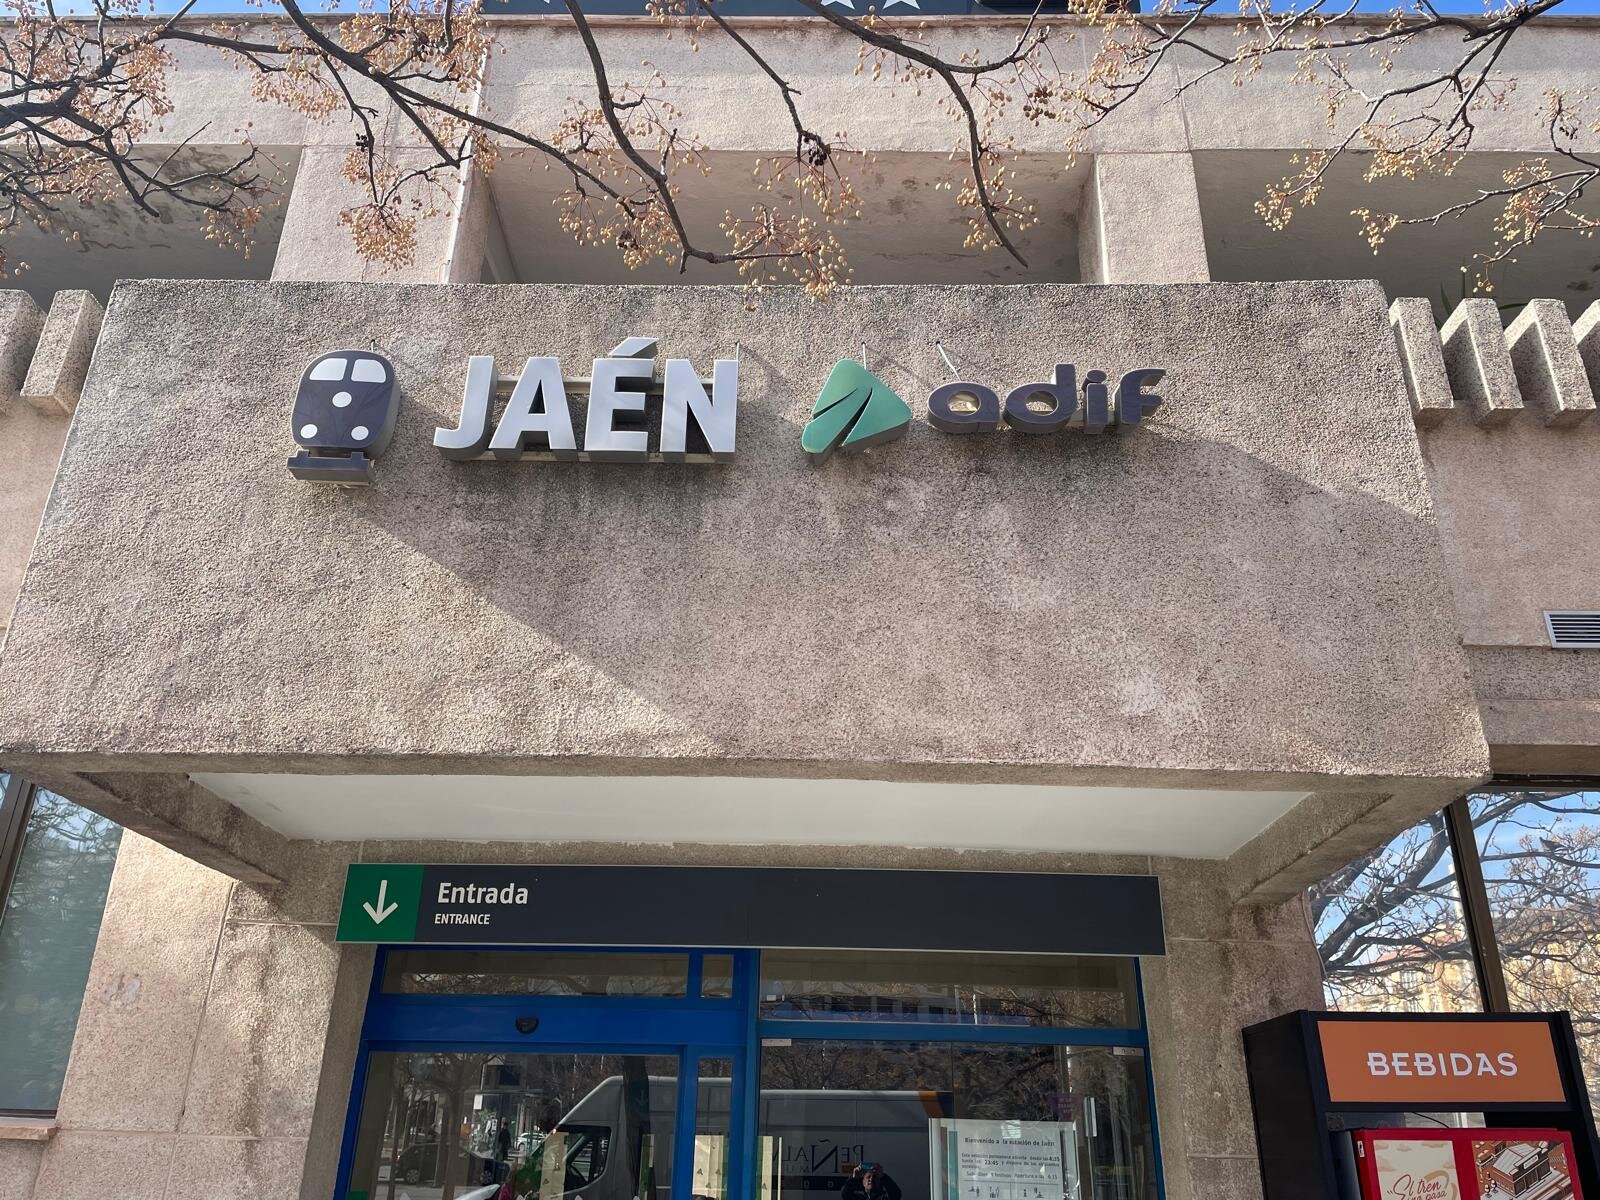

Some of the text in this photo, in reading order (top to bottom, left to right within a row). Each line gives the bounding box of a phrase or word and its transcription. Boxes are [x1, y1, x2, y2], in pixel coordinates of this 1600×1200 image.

[433, 337, 738, 460] JAÉN
[927, 363, 1166, 434] adif
[437, 882, 529, 905] Entrada
[434, 913, 491, 925] ENTRANCE
[1367, 1052, 1518, 1076] BEBIDAS
[1417, 1178, 1442, 1195] tren
